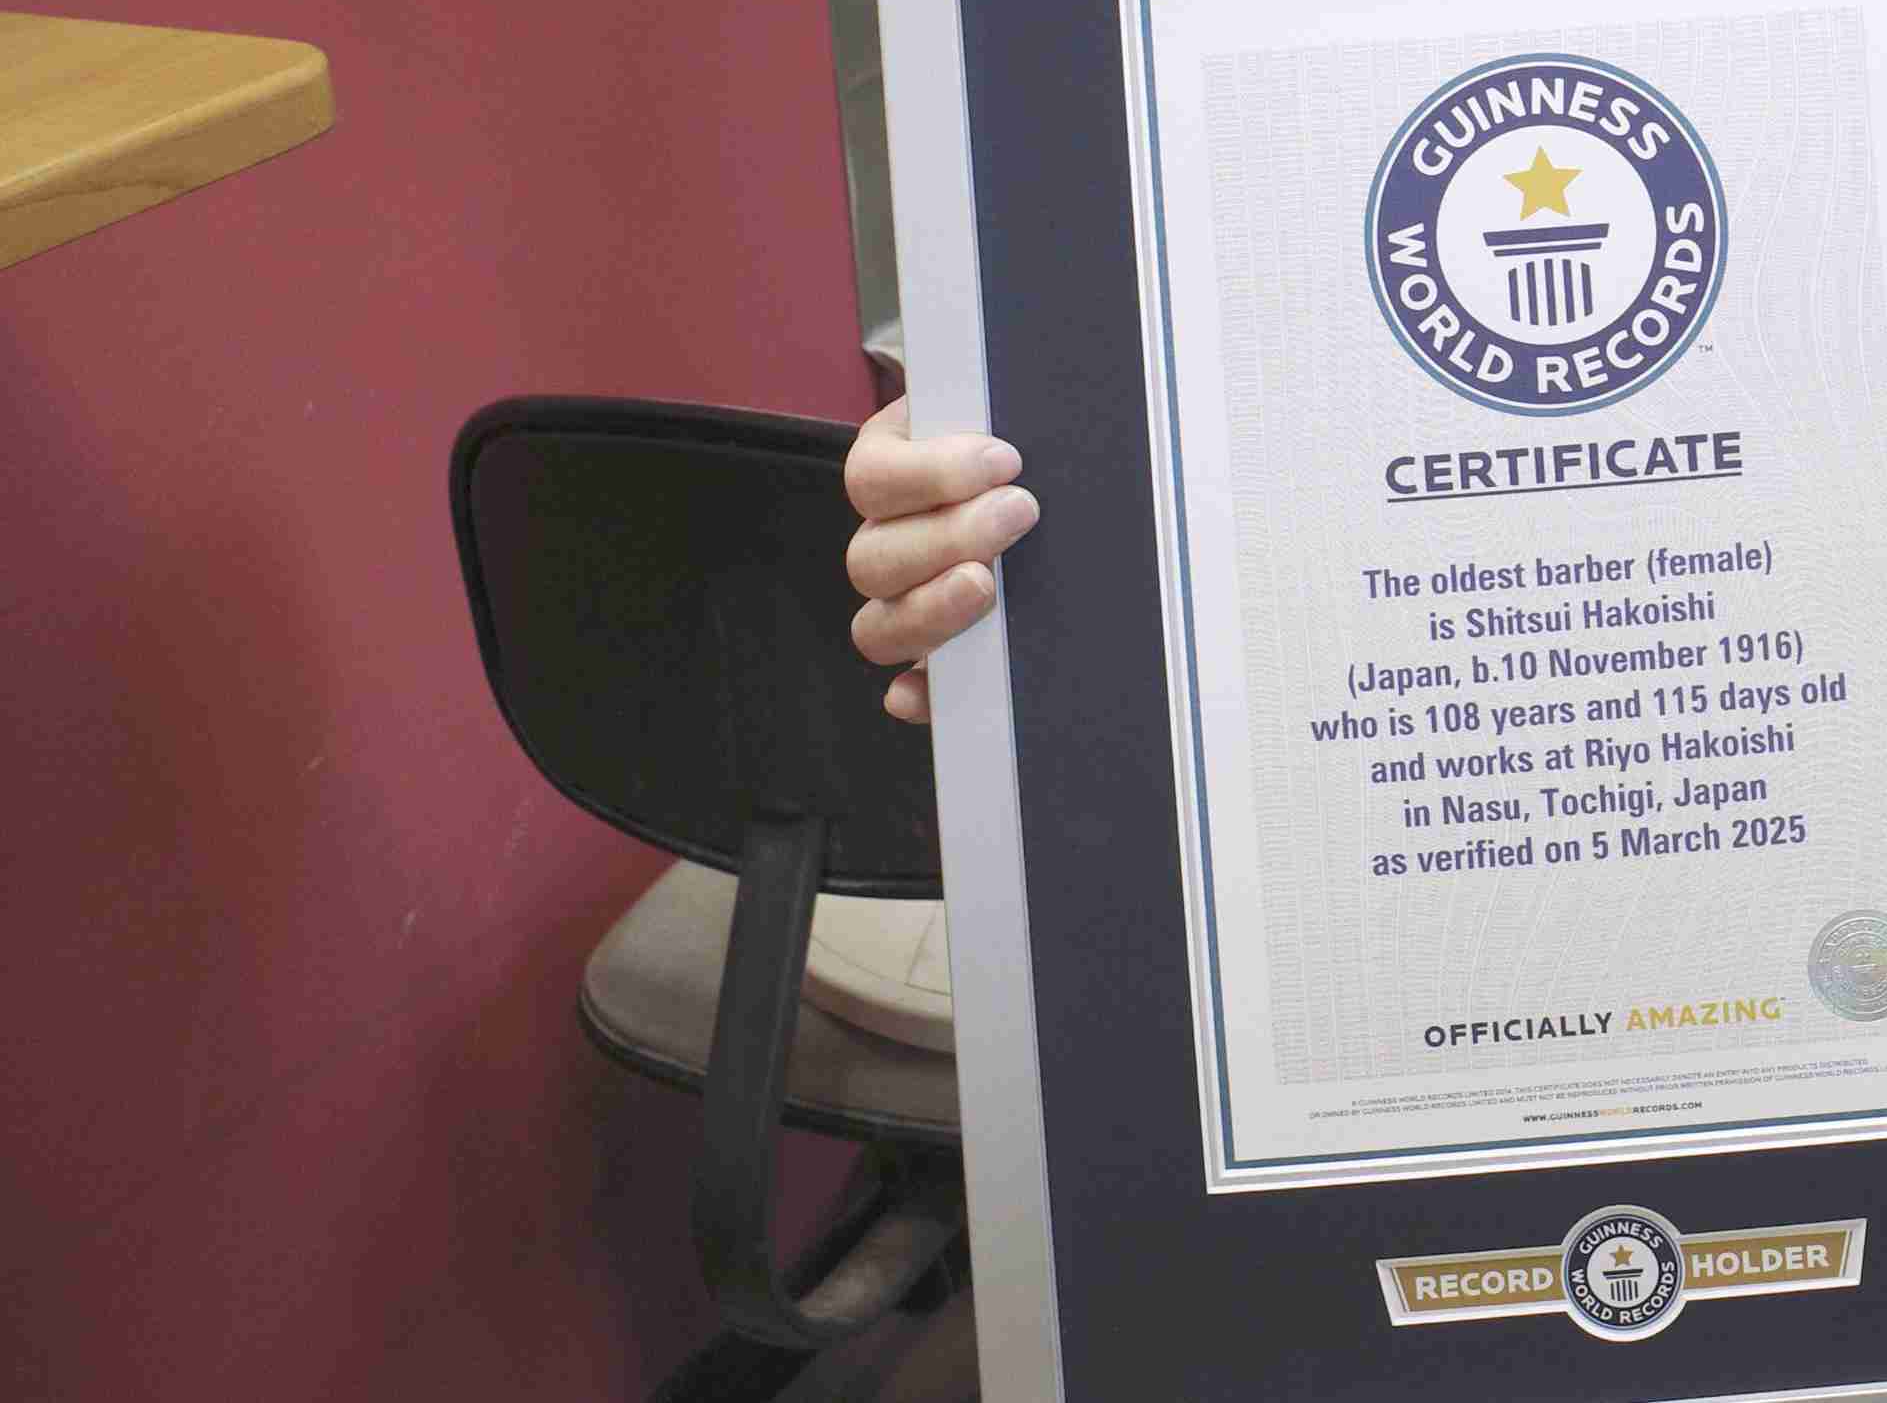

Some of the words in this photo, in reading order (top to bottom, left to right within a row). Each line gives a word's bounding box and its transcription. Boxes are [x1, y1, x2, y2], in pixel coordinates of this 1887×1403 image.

[1412, 77, 1671, 177] GUINNESS
[1387, 222, 1514, 385] WORLD
[1536, 201, 1705, 395] RECORDS
[1384, 430, 1743, 495] CERTIFICATE
[1361, 567, 1421, 600] The
[1430, 562, 1527, 596] oldest
[1534, 553, 1636, 588] barber
[1646, 539, 1773, 586] (female)
[1428, 611, 1456, 642] is
[1465, 601, 1572, 639] Shitsui
[1582, 589, 1716, 630] Hakoishi
[1347, 661, 1462, 701] (Japan,
[1471, 650, 1538, 685] b.10
[1548, 639, 1709, 679] November
[1718, 629, 1804, 666] 1916)
[1309, 709, 1379, 743] who
[1387, 706, 1416, 738] is
[1424, 701, 1482, 735] 108
[1490, 701, 1577, 737] years
[1586, 688, 1642, 723] and
[1652, 683, 1709, 717] 115
[1718, 680, 1792, 716] days
[1800, 671, 1847, 705] old
[1370, 750, 1427, 785] and
[1434, 744, 1535, 780] works
[1544, 743, 1576, 772] at
[1584, 736, 1652, 774] Riyo
[1660, 721, 1795, 763] Hakoishi
[1402, 797, 1432, 829] in
[1441, 794, 1531, 826] Nasu,
[1538, 779, 1664, 819] Tochigi,
[1672, 776, 1768, 812] Japan
[1371, 852, 1409, 877] as
[1416, 835, 1534, 874] verified
[1543, 839, 1582, 865] on
[1591, 830, 1610, 861] 5
[1620, 821, 1722, 859] March
[1731, 813, 1807, 850] 2025
[1423, 1010, 1613, 1048] OFFICIALLY
[1626, 996, 1783, 1031] AMAZING
[1580, 1221, 1664, 1255] GUINNESS
[1414, 1266, 1554, 1302] RECORD
[1690, 1243, 1830, 1279] HOLDER
[1571, 1268, 1613, 1321] WORLD
[1619, 1260, 1675, 1324] RECORDS
